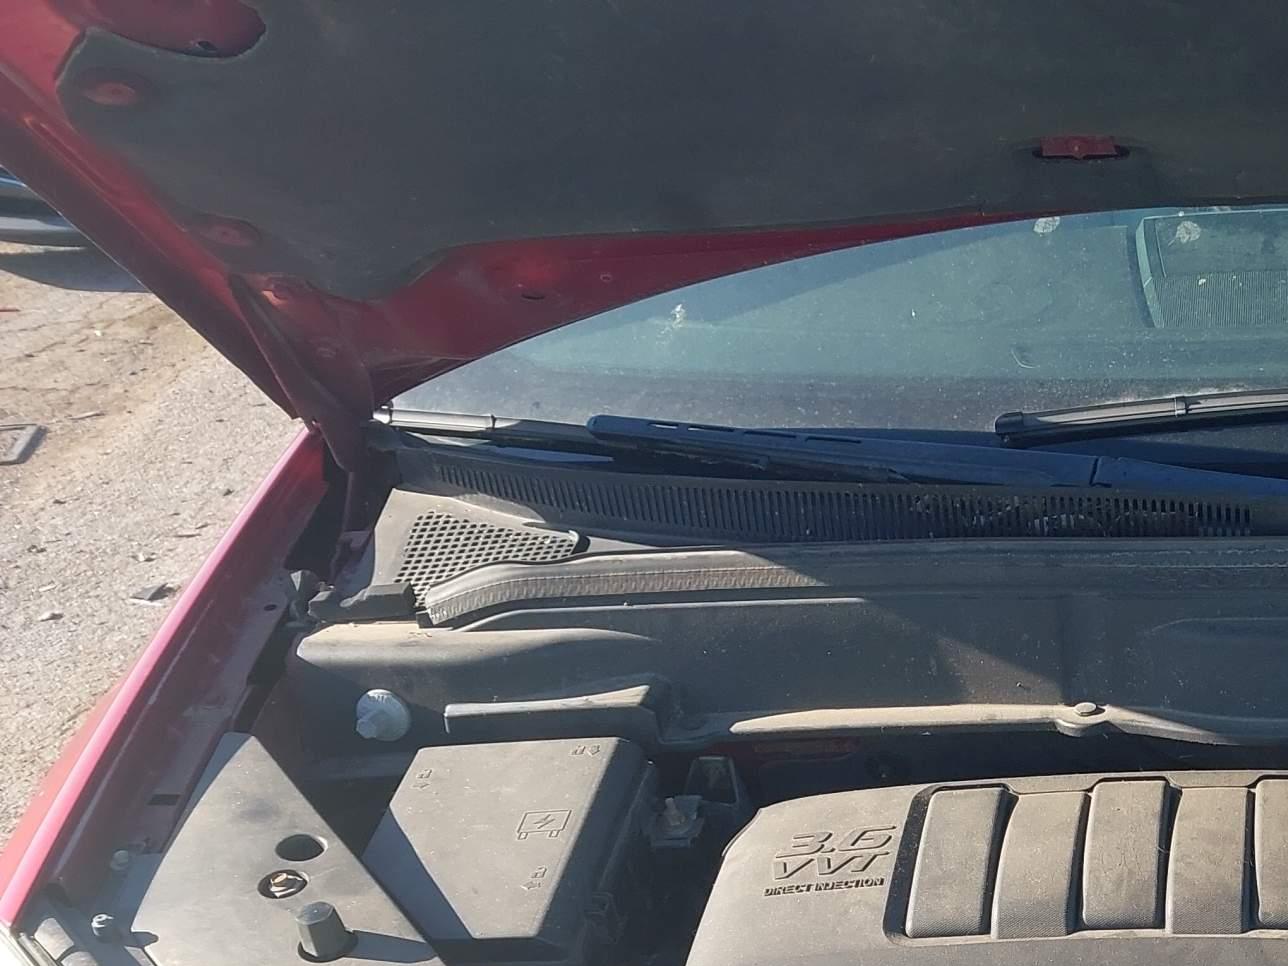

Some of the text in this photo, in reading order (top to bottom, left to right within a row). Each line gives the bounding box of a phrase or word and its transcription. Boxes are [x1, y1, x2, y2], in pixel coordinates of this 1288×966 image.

[775, 825, 897, 858] 3.6
[773, 851, 890, 880] VVT
[764, 877, 885, 897] DIRECT INJECTION
